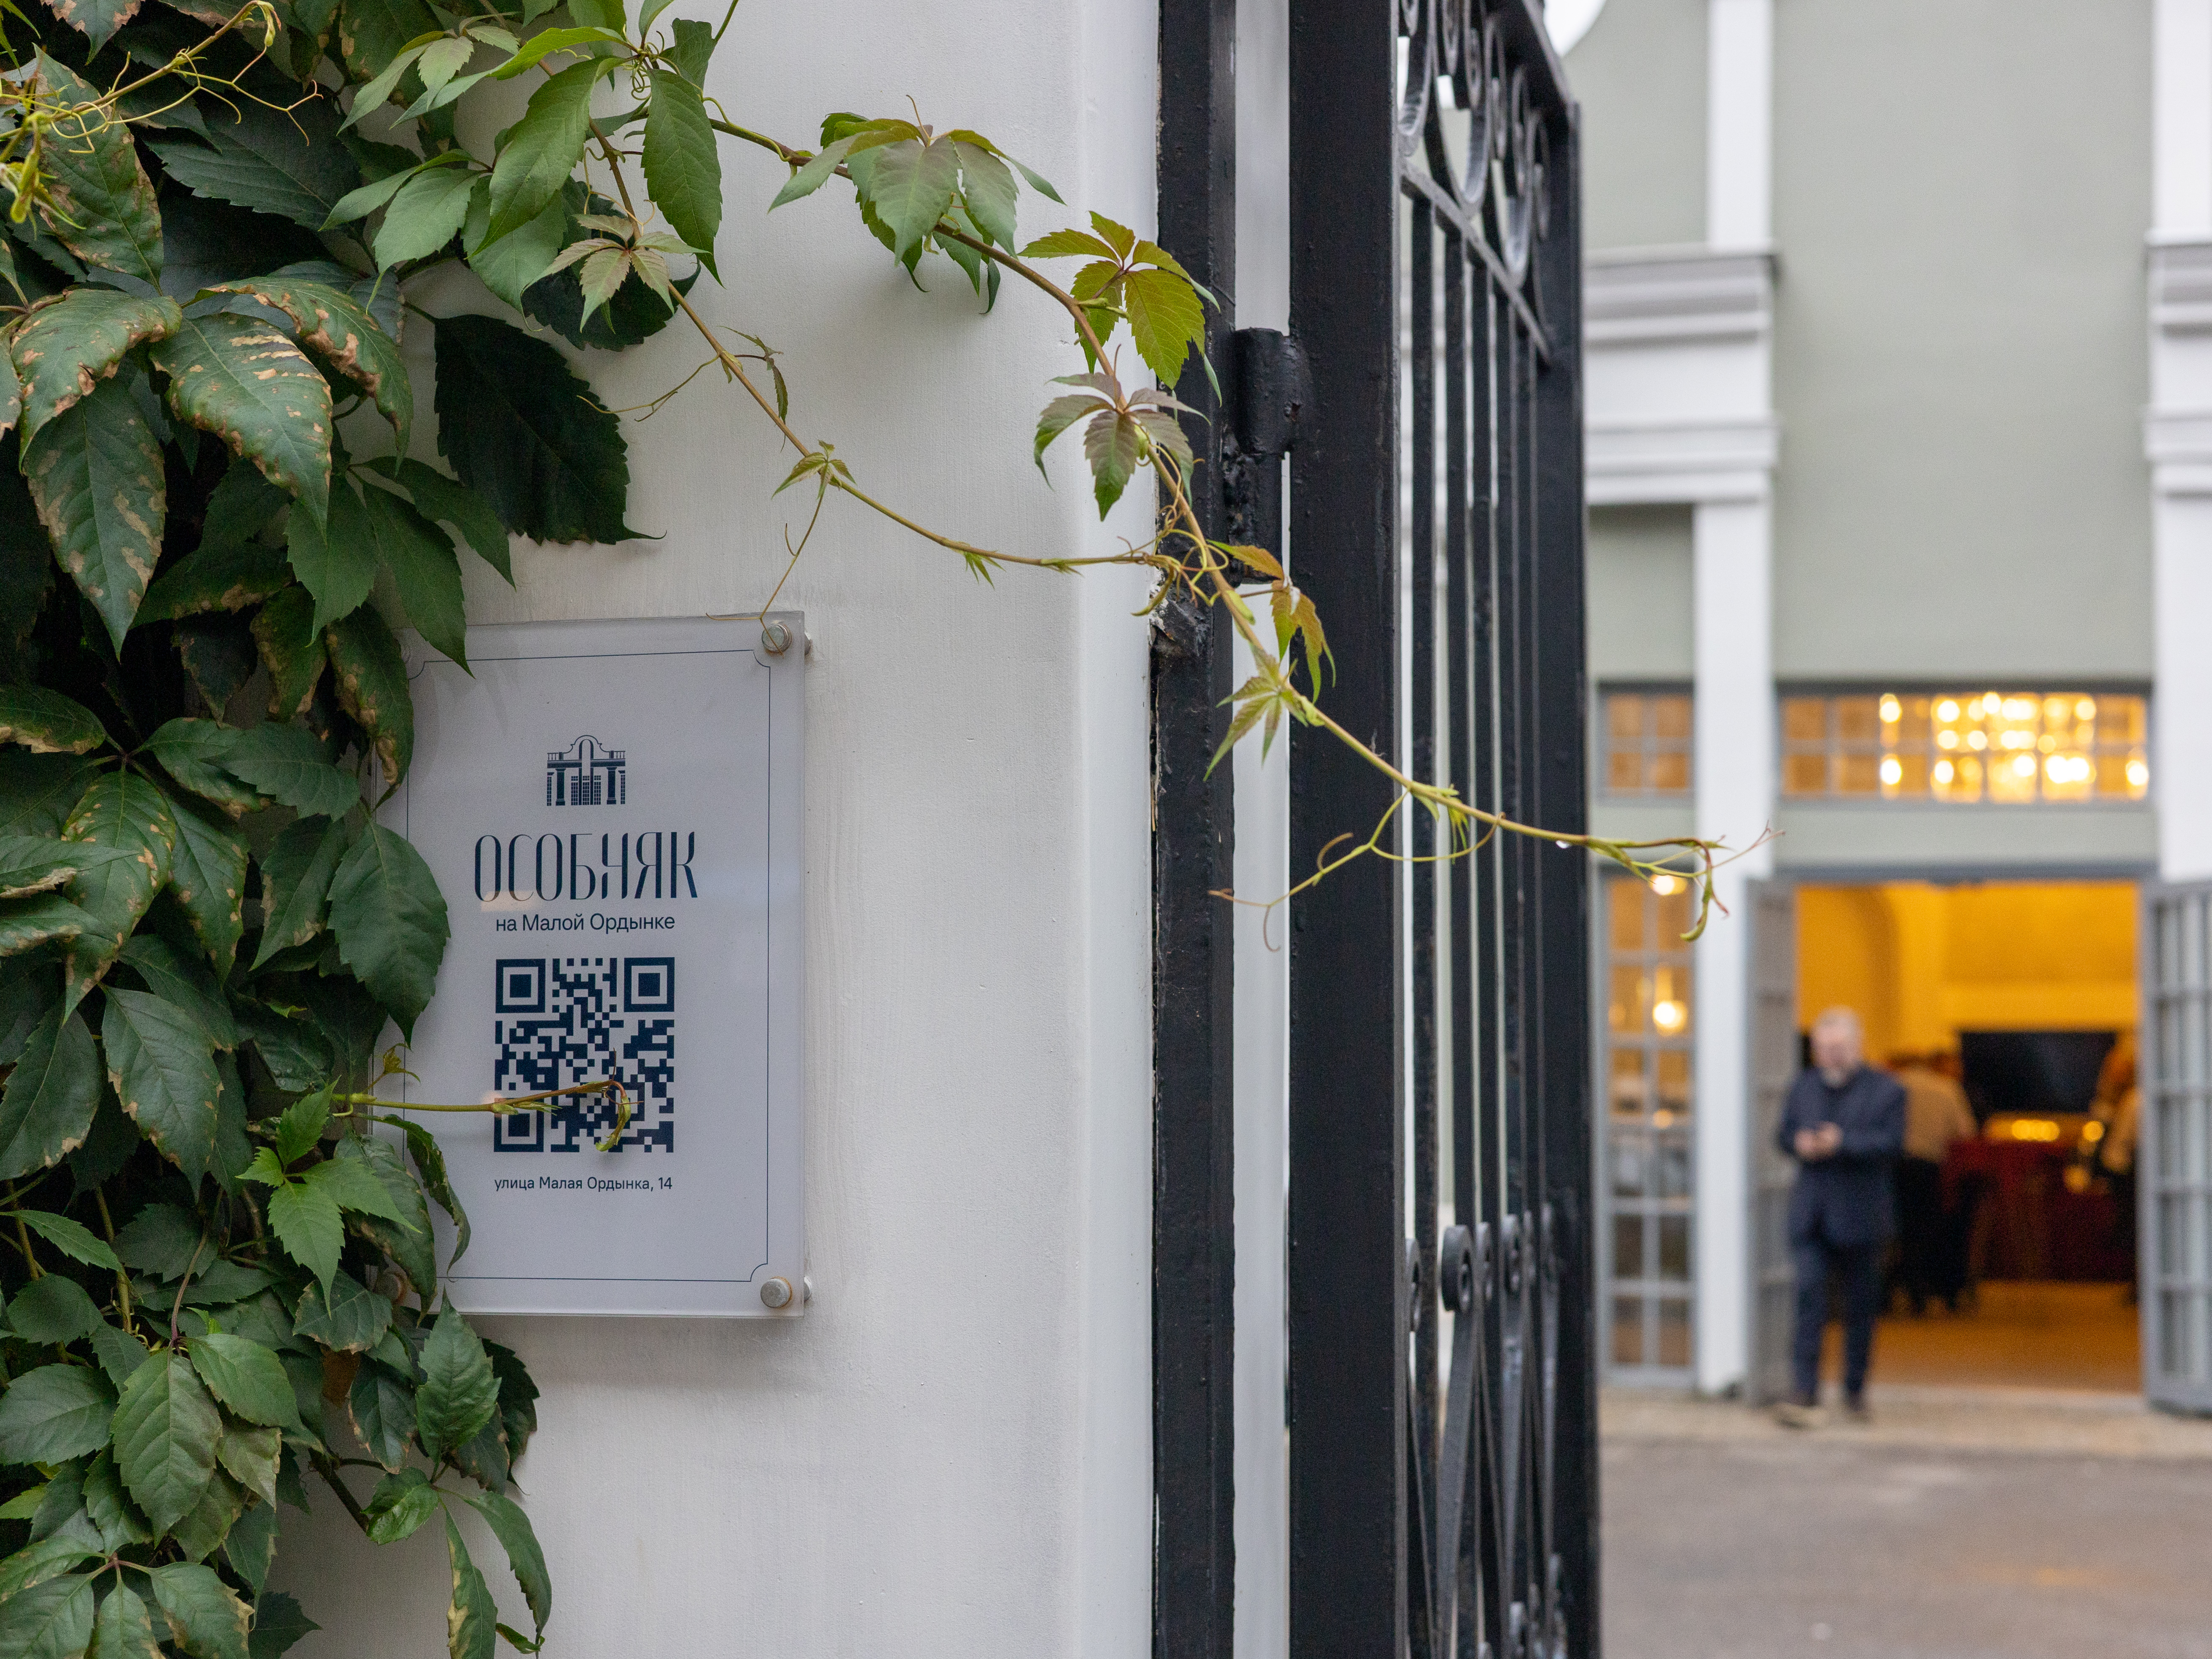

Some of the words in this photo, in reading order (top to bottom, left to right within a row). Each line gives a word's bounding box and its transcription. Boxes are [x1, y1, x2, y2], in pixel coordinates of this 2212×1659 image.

[474, 831, 698, 902] ОСОБНЯК
[496, 918, 517, 931] на
[522, 913, 584, 931] Малой
[590, 913, 675, 934] Ордынке
[494, 1179, 535, 1192] улица
[539, 1176, 583, 1189] Малая
[587, 1176, 653, 1192] Ордынка,
[658, 1177, 673, 1189] 14
